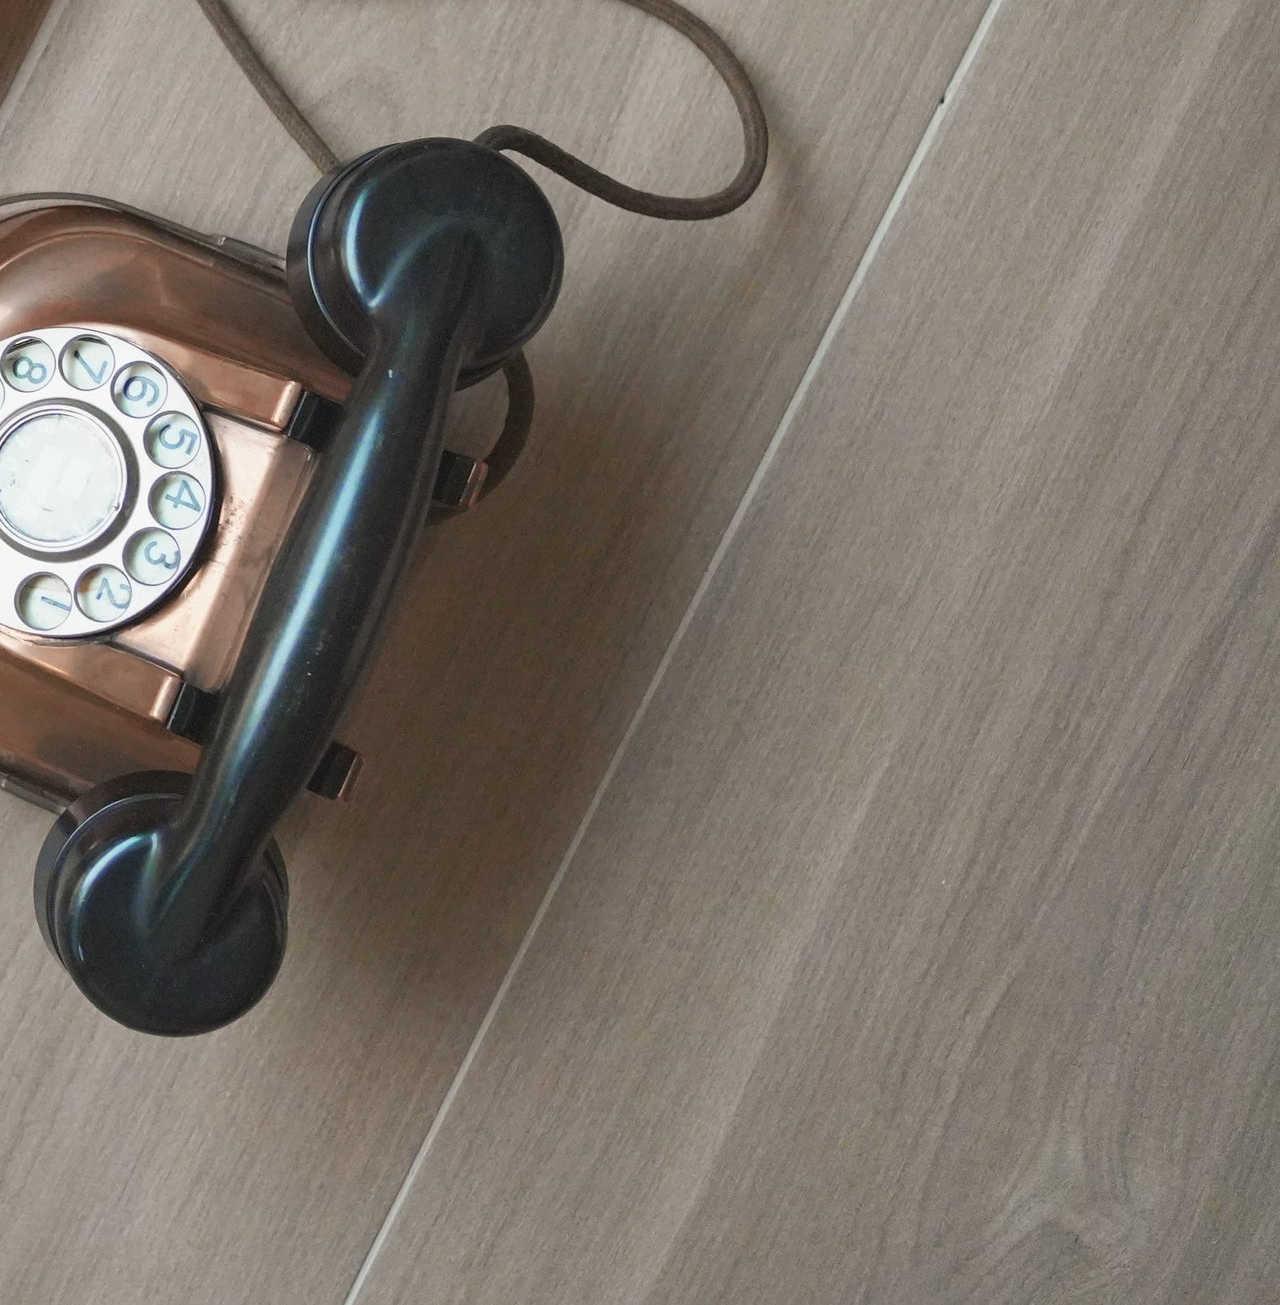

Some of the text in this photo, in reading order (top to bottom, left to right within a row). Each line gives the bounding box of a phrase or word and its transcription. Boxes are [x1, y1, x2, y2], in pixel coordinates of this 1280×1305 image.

[13, 356, 47, 384] 8
[74, 350, 109, 384] 7
[124, 376, 159, 407] 6
[159, 424, 199, 456] 5
[165, 480, 202, 513] 4
[143, 540, 181, 570] 3
[41, 596, 70, 611] 1
[96, 577, 132, 609] 2
